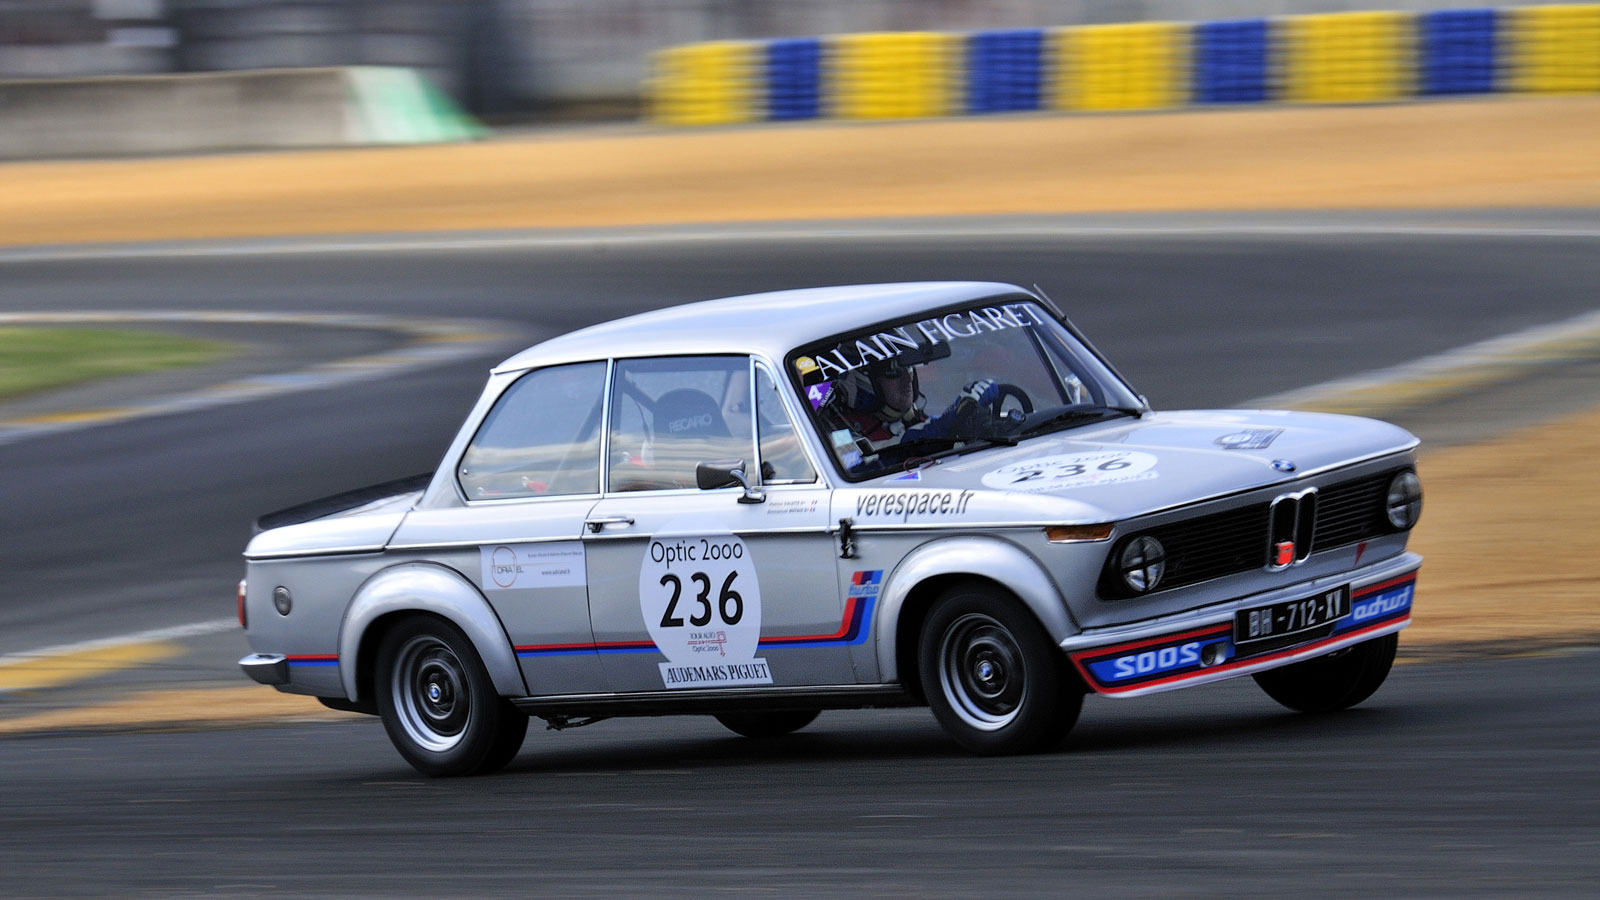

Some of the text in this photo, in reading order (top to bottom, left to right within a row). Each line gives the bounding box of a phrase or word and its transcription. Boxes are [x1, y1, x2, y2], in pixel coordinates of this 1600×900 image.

[815, 303, 1044, 381] ALAIN FIGARET
[808, 384, 823, 401] 4
[668, 413, 712, 433] RECARO
[1011, 458, 1132, 484] 236
[857, 489, 975, 523] verespace.fr
[650, 538, 743, 569] Optic 2000
[660, 569, 744, 628] 236
[848, 580, 879, 597] turbo
[692, 645, 706, 653] Optic
[667, 663, 768, 683] AUDEMARS PIGUET
